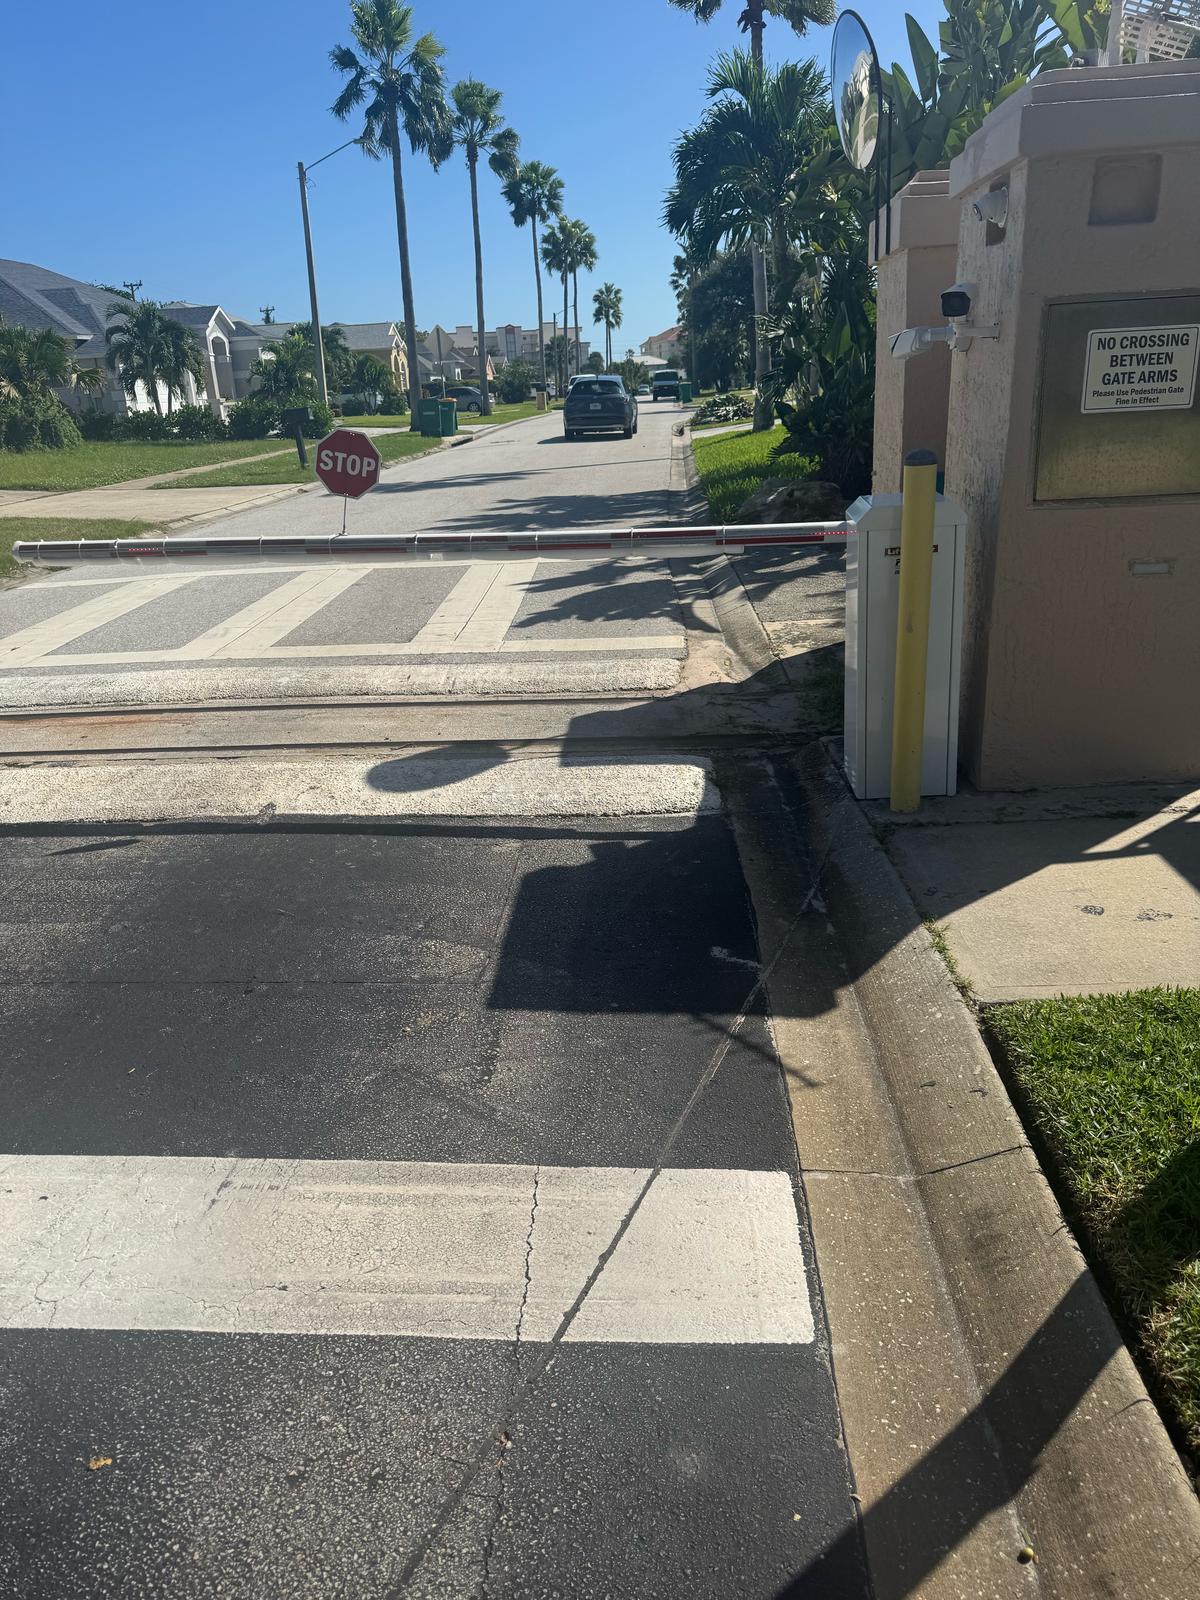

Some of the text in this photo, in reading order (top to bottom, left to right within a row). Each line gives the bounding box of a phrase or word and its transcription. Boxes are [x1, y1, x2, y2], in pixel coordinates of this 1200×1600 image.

[1097, 333, 1190, 350] NO CROSSING
[1109, 352, 1174, 367] BETWEEN
[1102, 369, 1178, 385] GATE ARMS
[1130, 387, 1166, 396] Pedestrian
[1168, 386, 1184, 394] Gate
[1139, 396, 1159, 404] Effect
[320, 450, 376, 477] STOP
